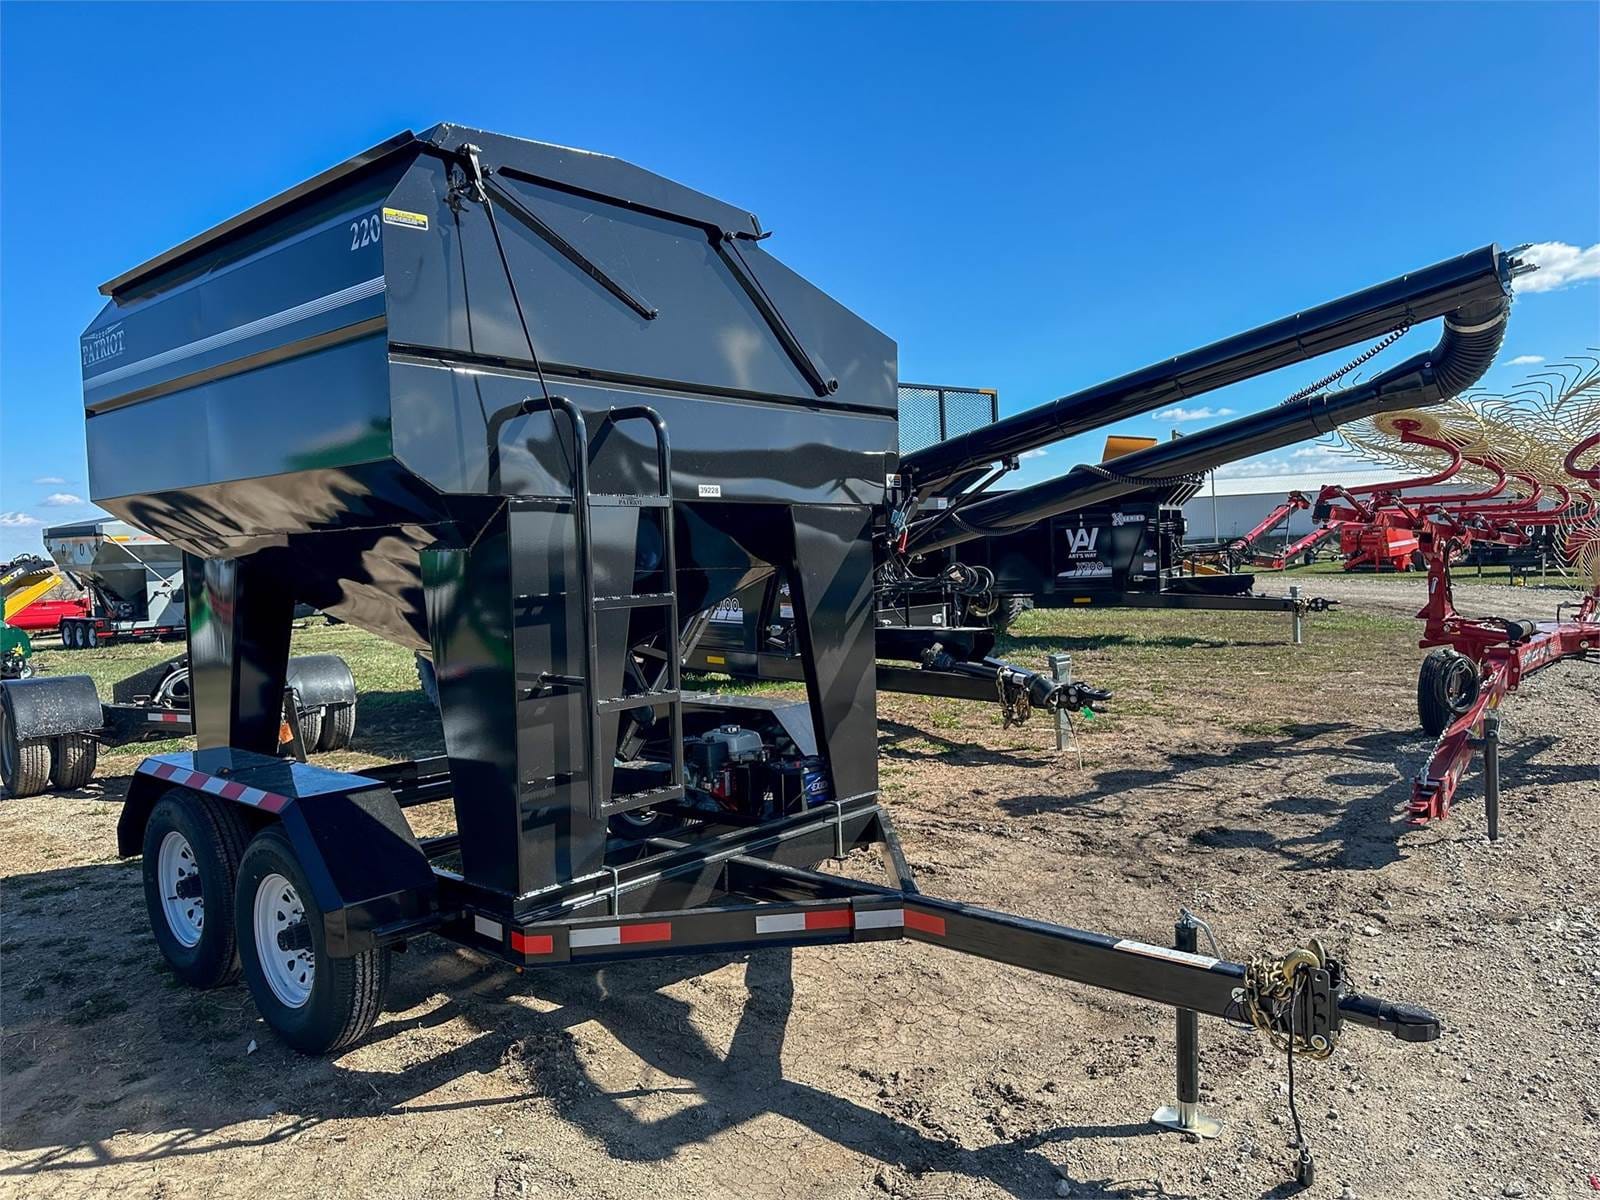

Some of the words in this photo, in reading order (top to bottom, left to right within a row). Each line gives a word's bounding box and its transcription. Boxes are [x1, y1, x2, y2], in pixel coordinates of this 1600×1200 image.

[350, 214, 381, 251] 220
[82, 329, 125, 365] PATRIOT
[700, 486, 719, 494] 39228
